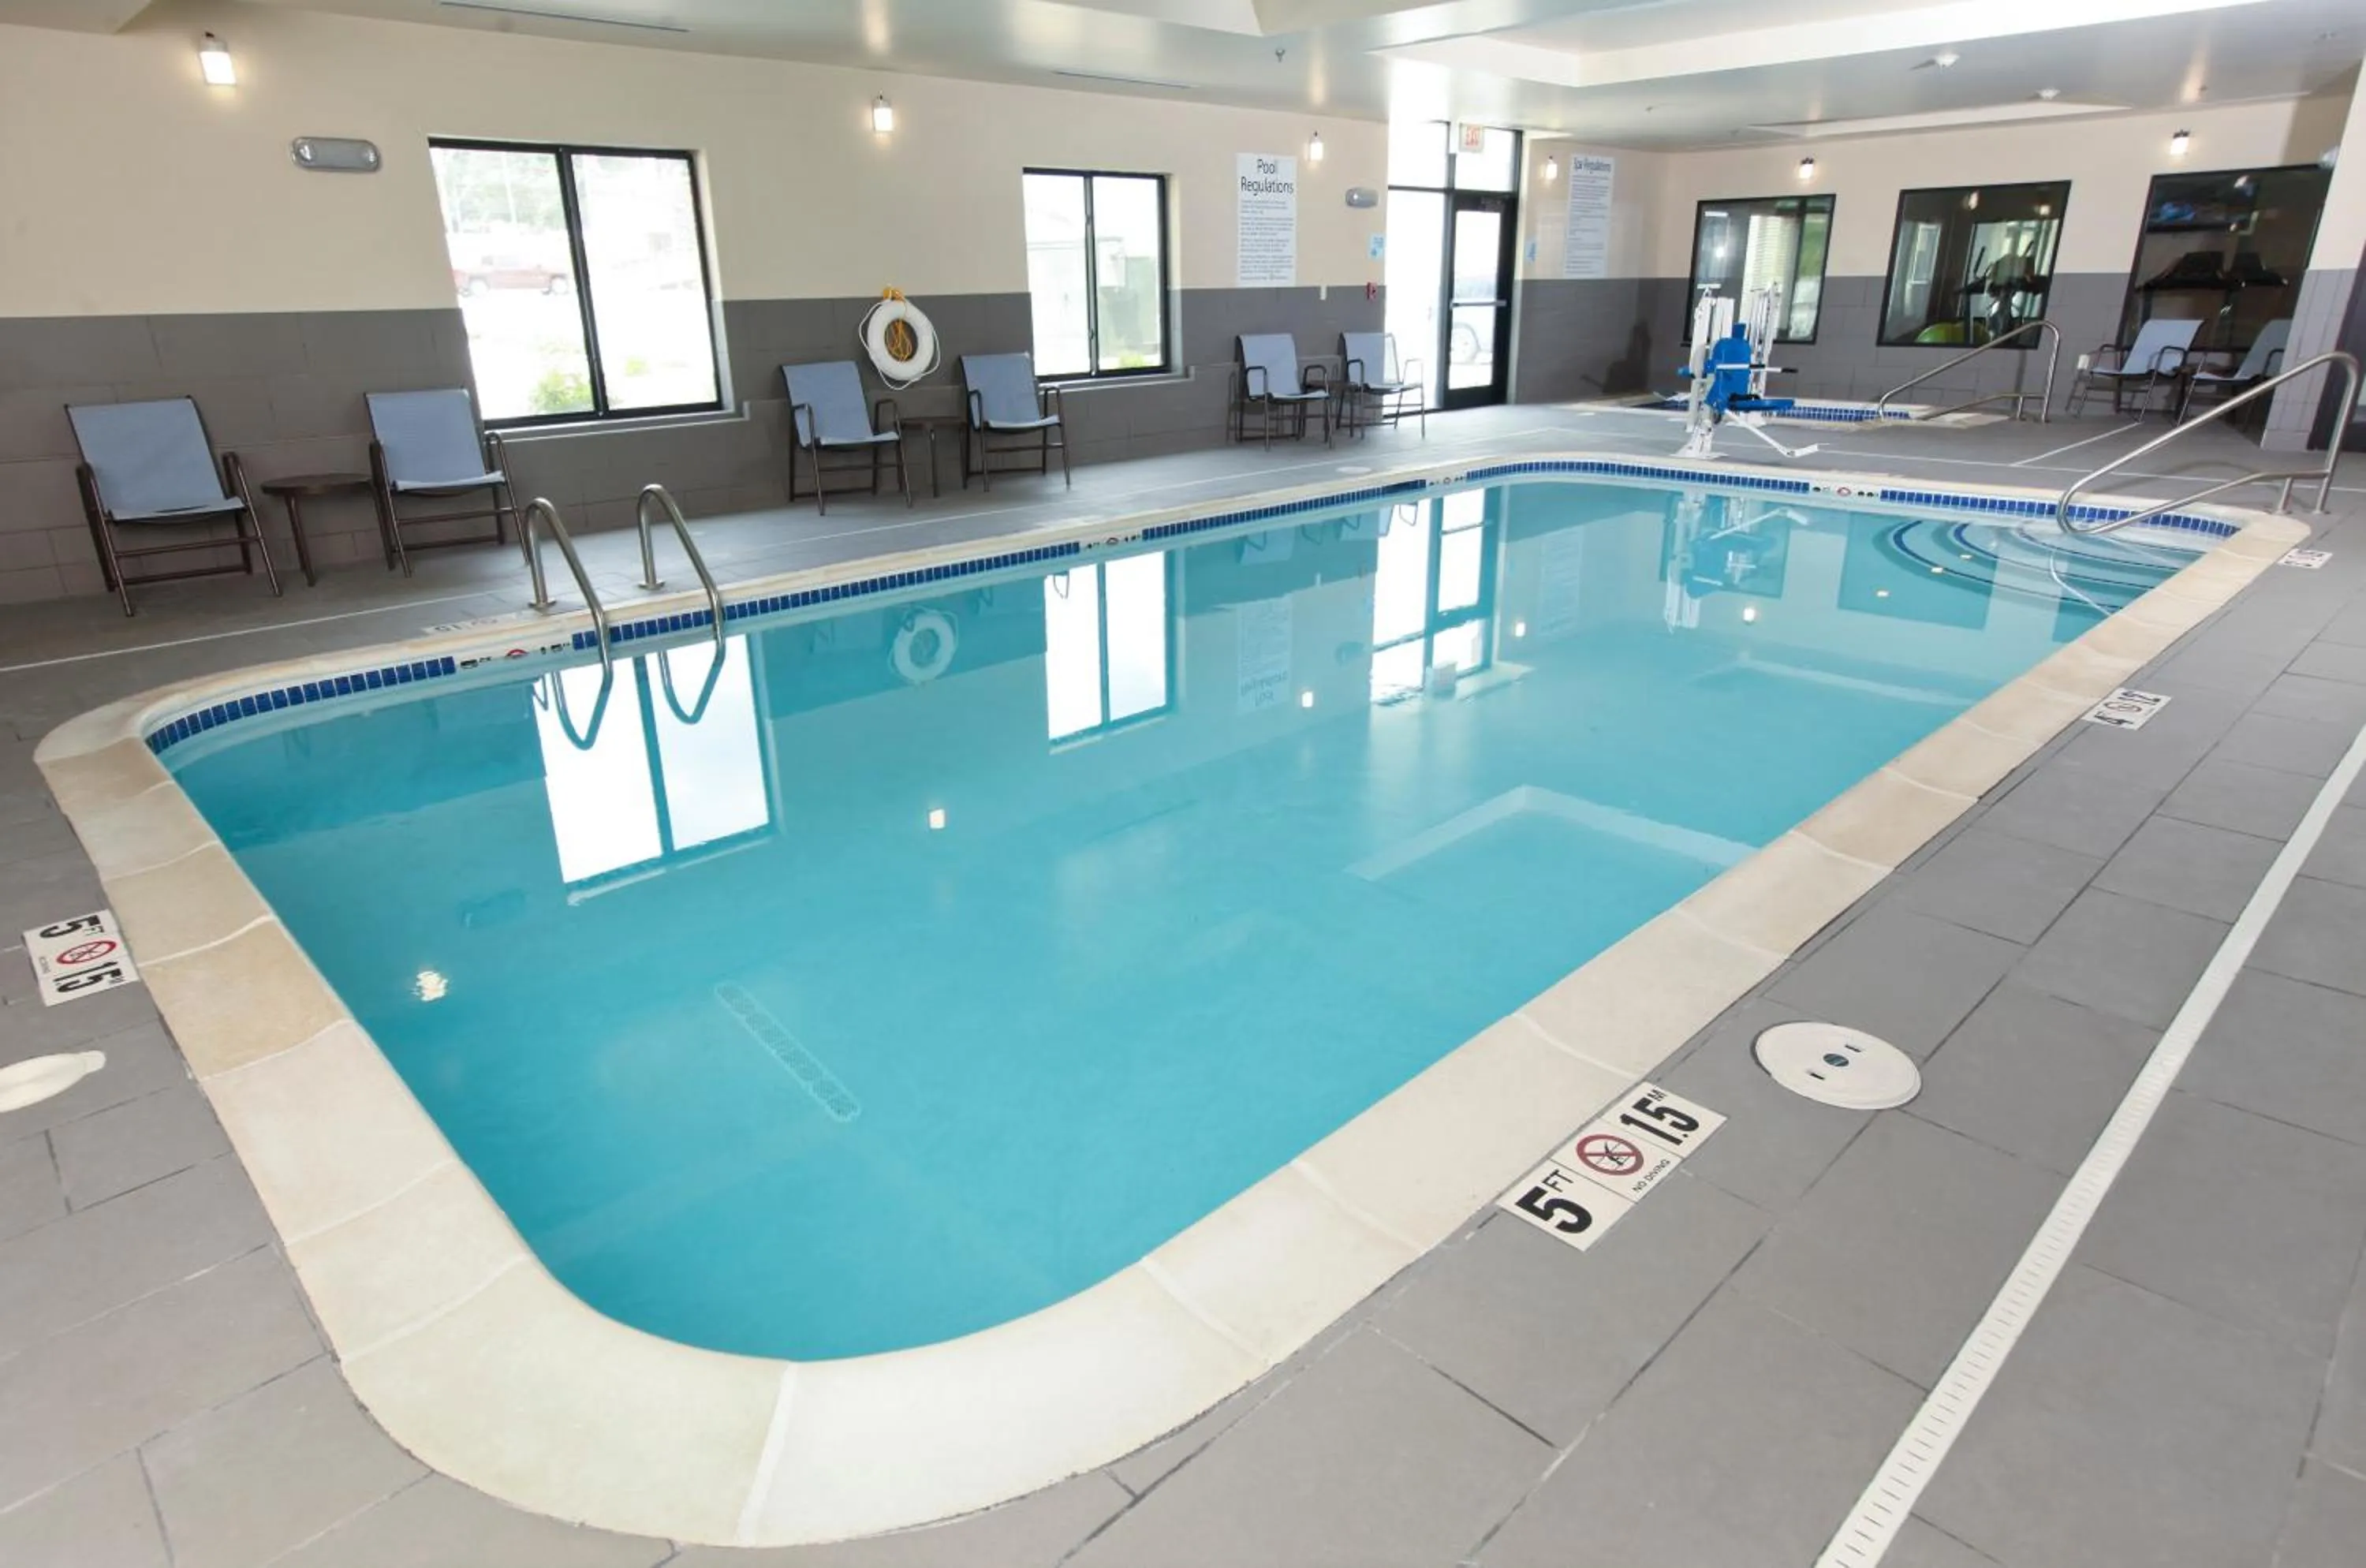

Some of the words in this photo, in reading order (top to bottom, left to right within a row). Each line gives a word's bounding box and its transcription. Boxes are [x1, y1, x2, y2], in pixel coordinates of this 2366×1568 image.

[1256, 159, 1278, 174] Pool
[1241, 176, 1294, 196] Regulations
[39, 915, 100, 939] 5
[1620, 1097, 1700, 1147] 1.5
[1542, 1169, 1574, 1193] FT
[1632, 1181, 1648, 1193] NO
[1643, 1159, 1670, 1182] DIVING
[1514, 1185, 1592, 1234] 5
